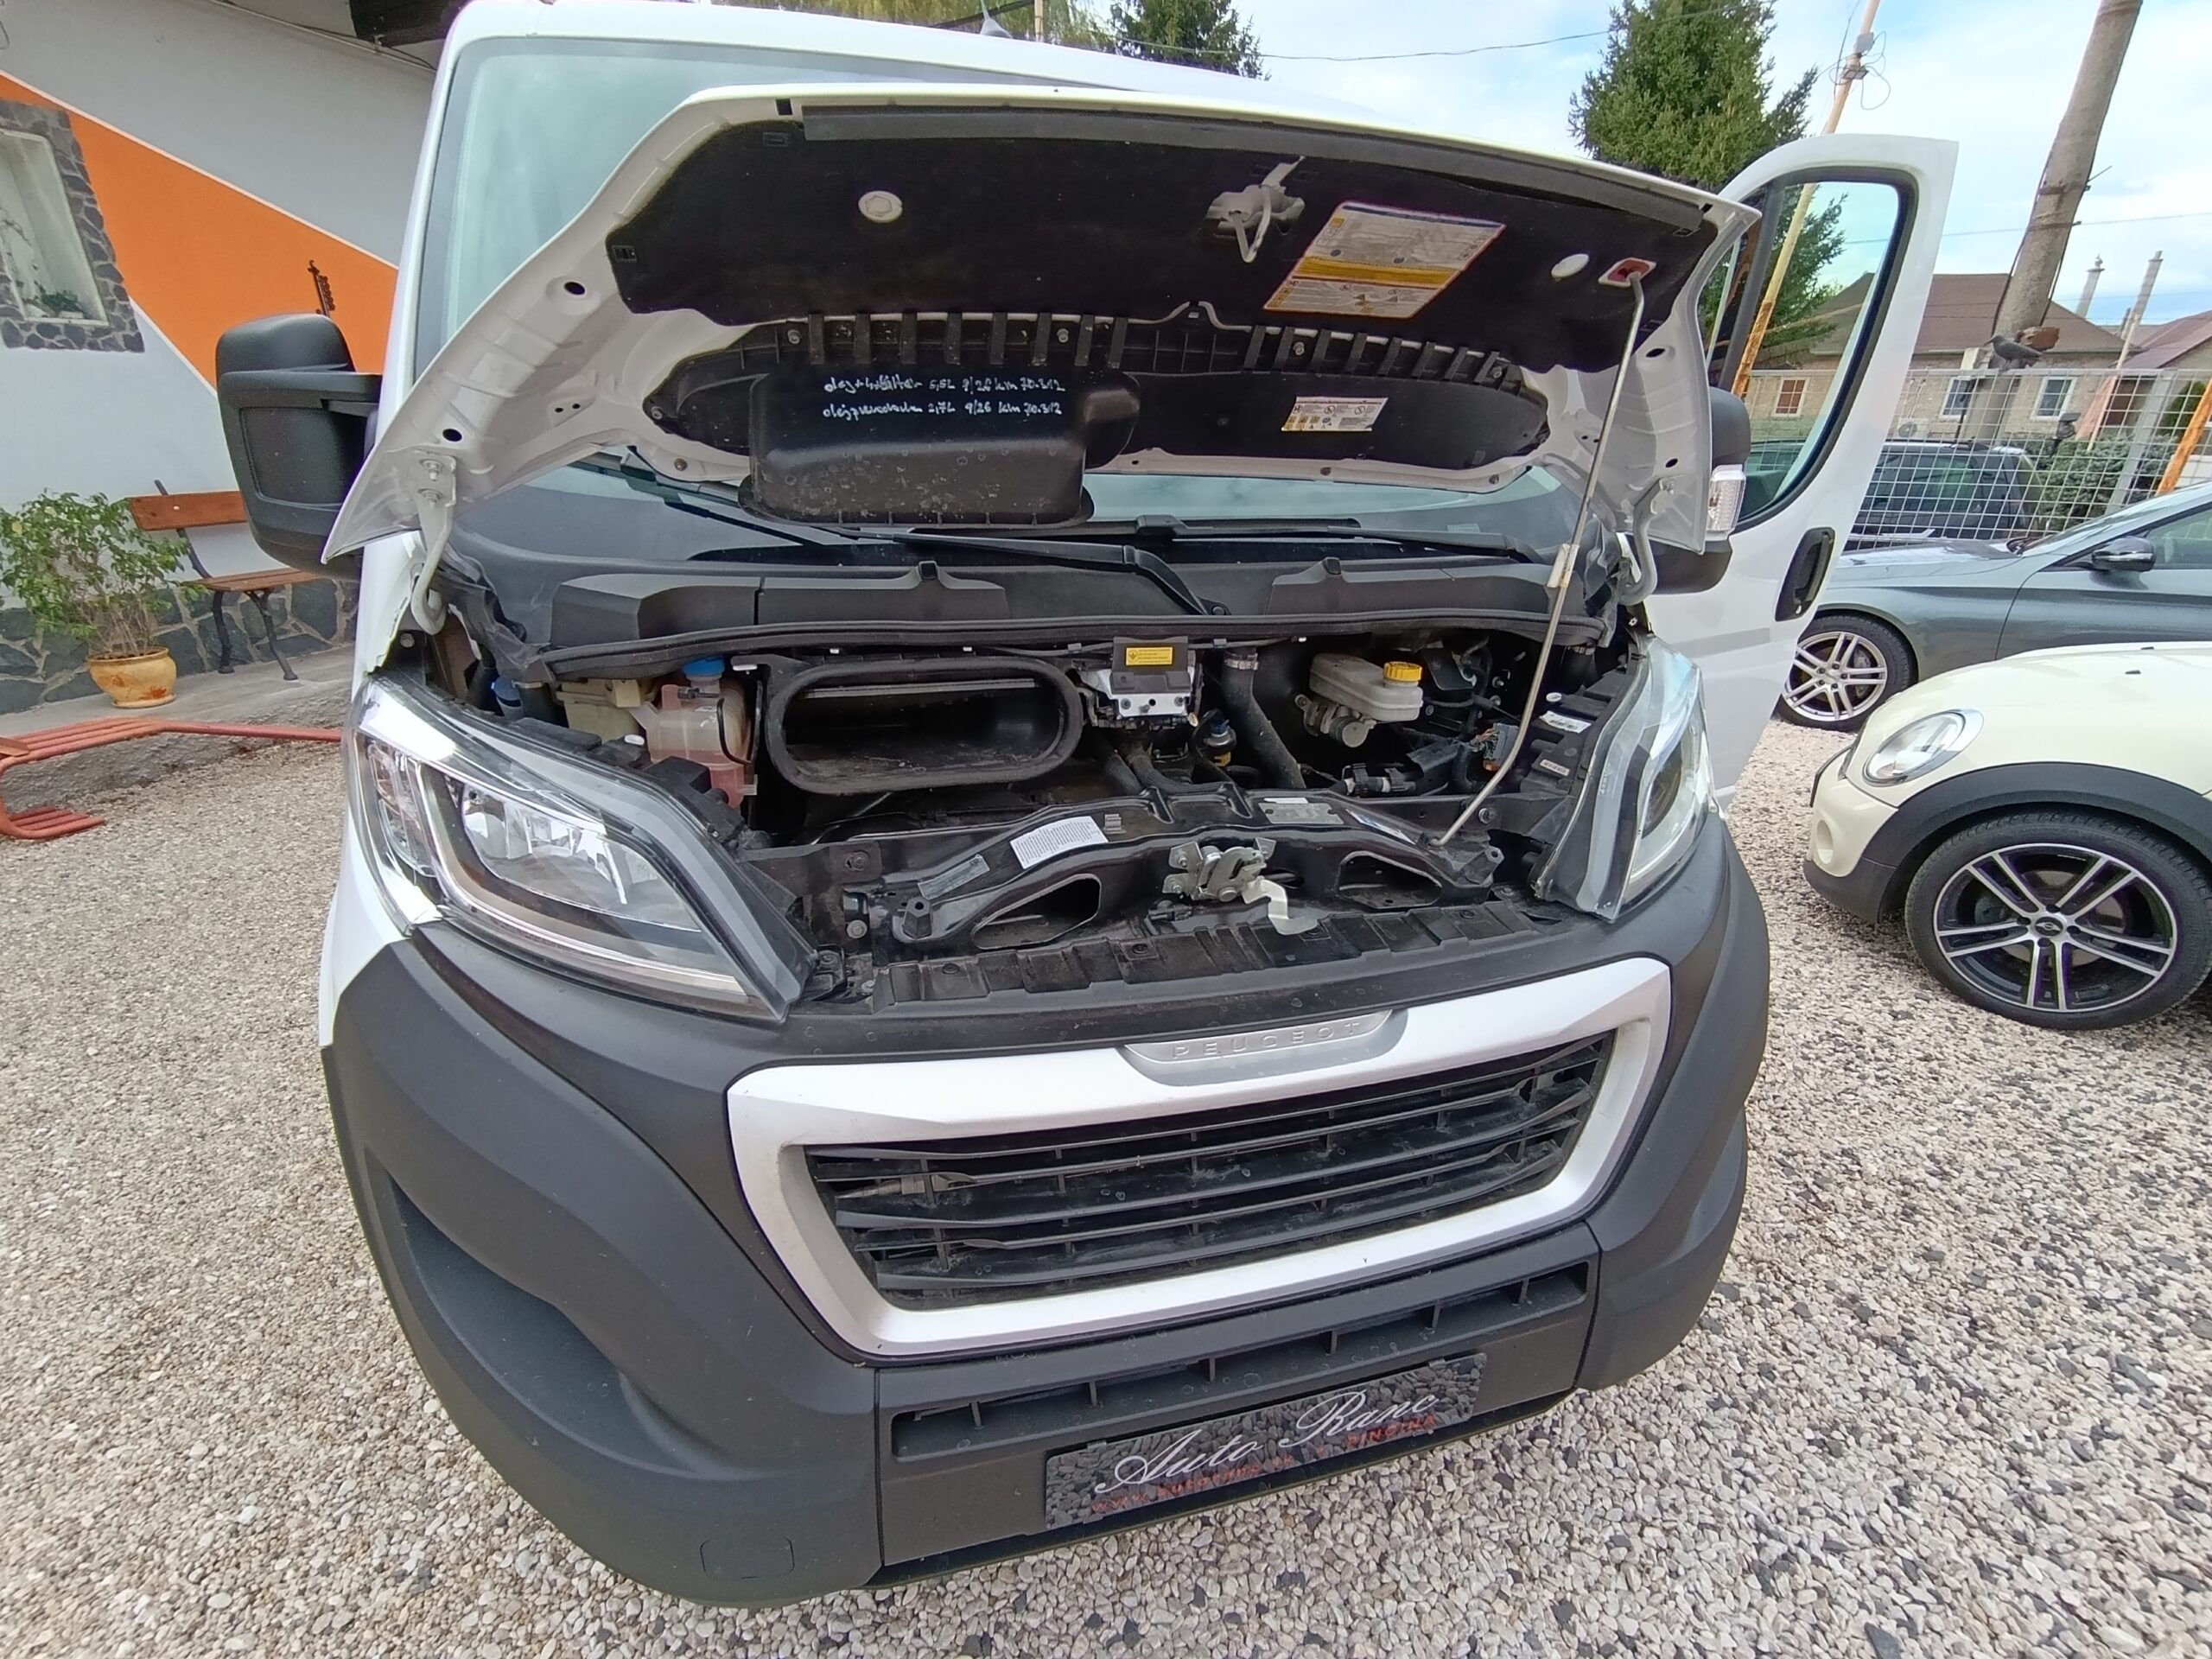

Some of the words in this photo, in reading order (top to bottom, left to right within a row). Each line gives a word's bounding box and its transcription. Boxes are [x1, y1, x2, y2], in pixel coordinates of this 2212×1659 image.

[994, 378, 1019, 391] km
[998, 401, 1021, 414] km
[1172, 1022, 1361, 1059] PEUGEOT
[1094, 1428, 1263, 1493] Auto
[1278, 1388, 1440, 1448] Ranc
